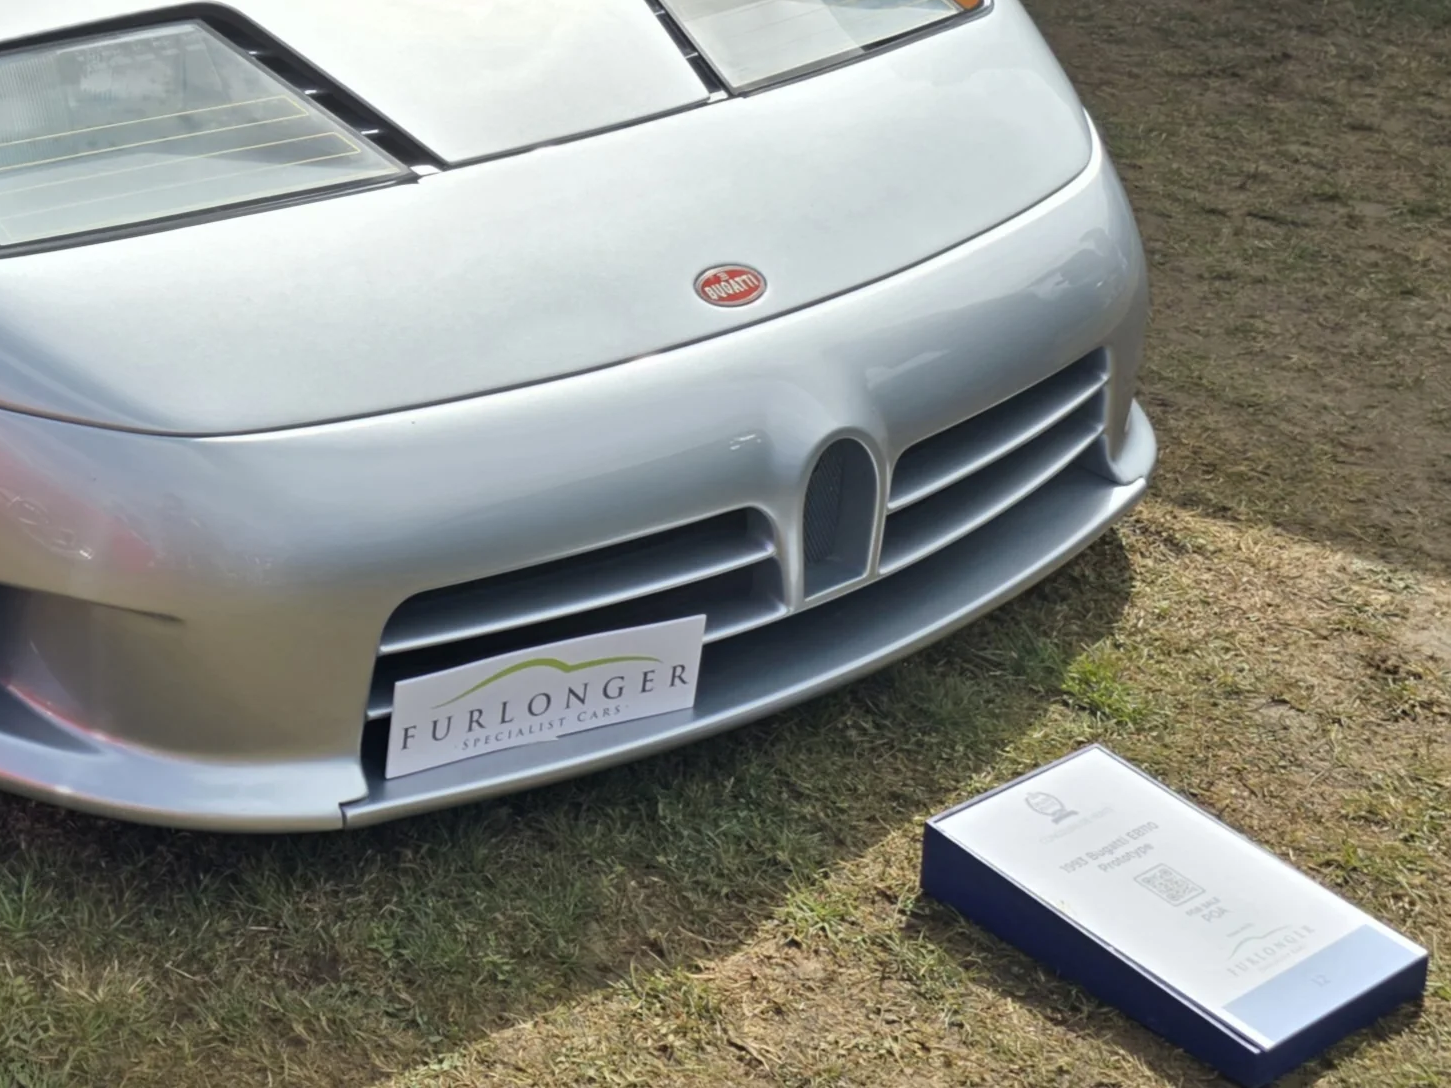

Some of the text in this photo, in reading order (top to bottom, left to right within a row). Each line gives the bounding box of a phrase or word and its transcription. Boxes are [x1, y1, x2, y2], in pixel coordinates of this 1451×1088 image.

[704, 273, 759, 300] BUGATTI
[401, 664, 689, 751] FURLONGER
[461, 705, 622, 751] SPECIALIST CARS
[1085, 835, 1130, 861] Bugatti
